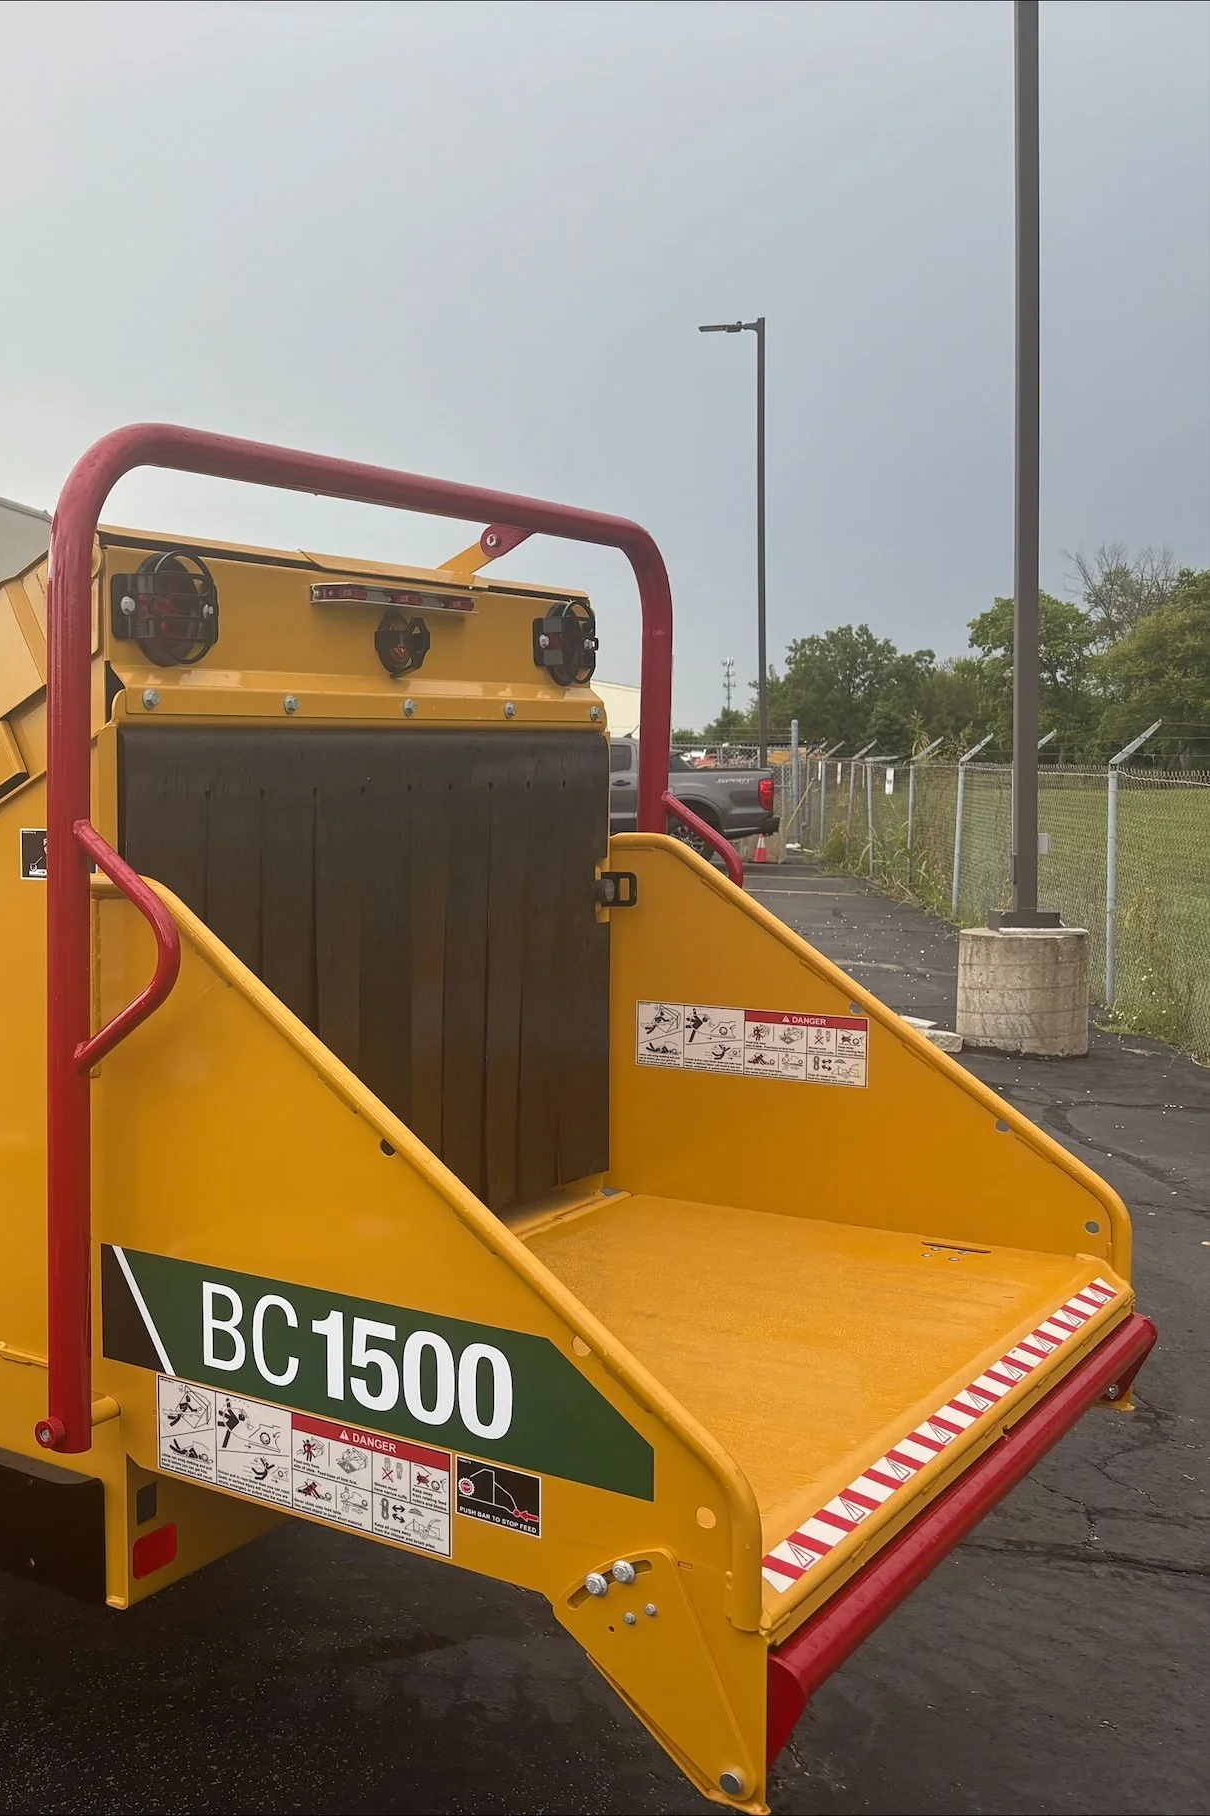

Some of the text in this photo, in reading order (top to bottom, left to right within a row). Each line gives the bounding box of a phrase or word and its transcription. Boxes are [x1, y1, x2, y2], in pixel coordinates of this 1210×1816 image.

[792, 1016, 827, 1026] DANGER
[352, 1432, 397, 1454] DANGER
[459, 1505, 537, 1534] PUSH BAR TO STOP FEED
